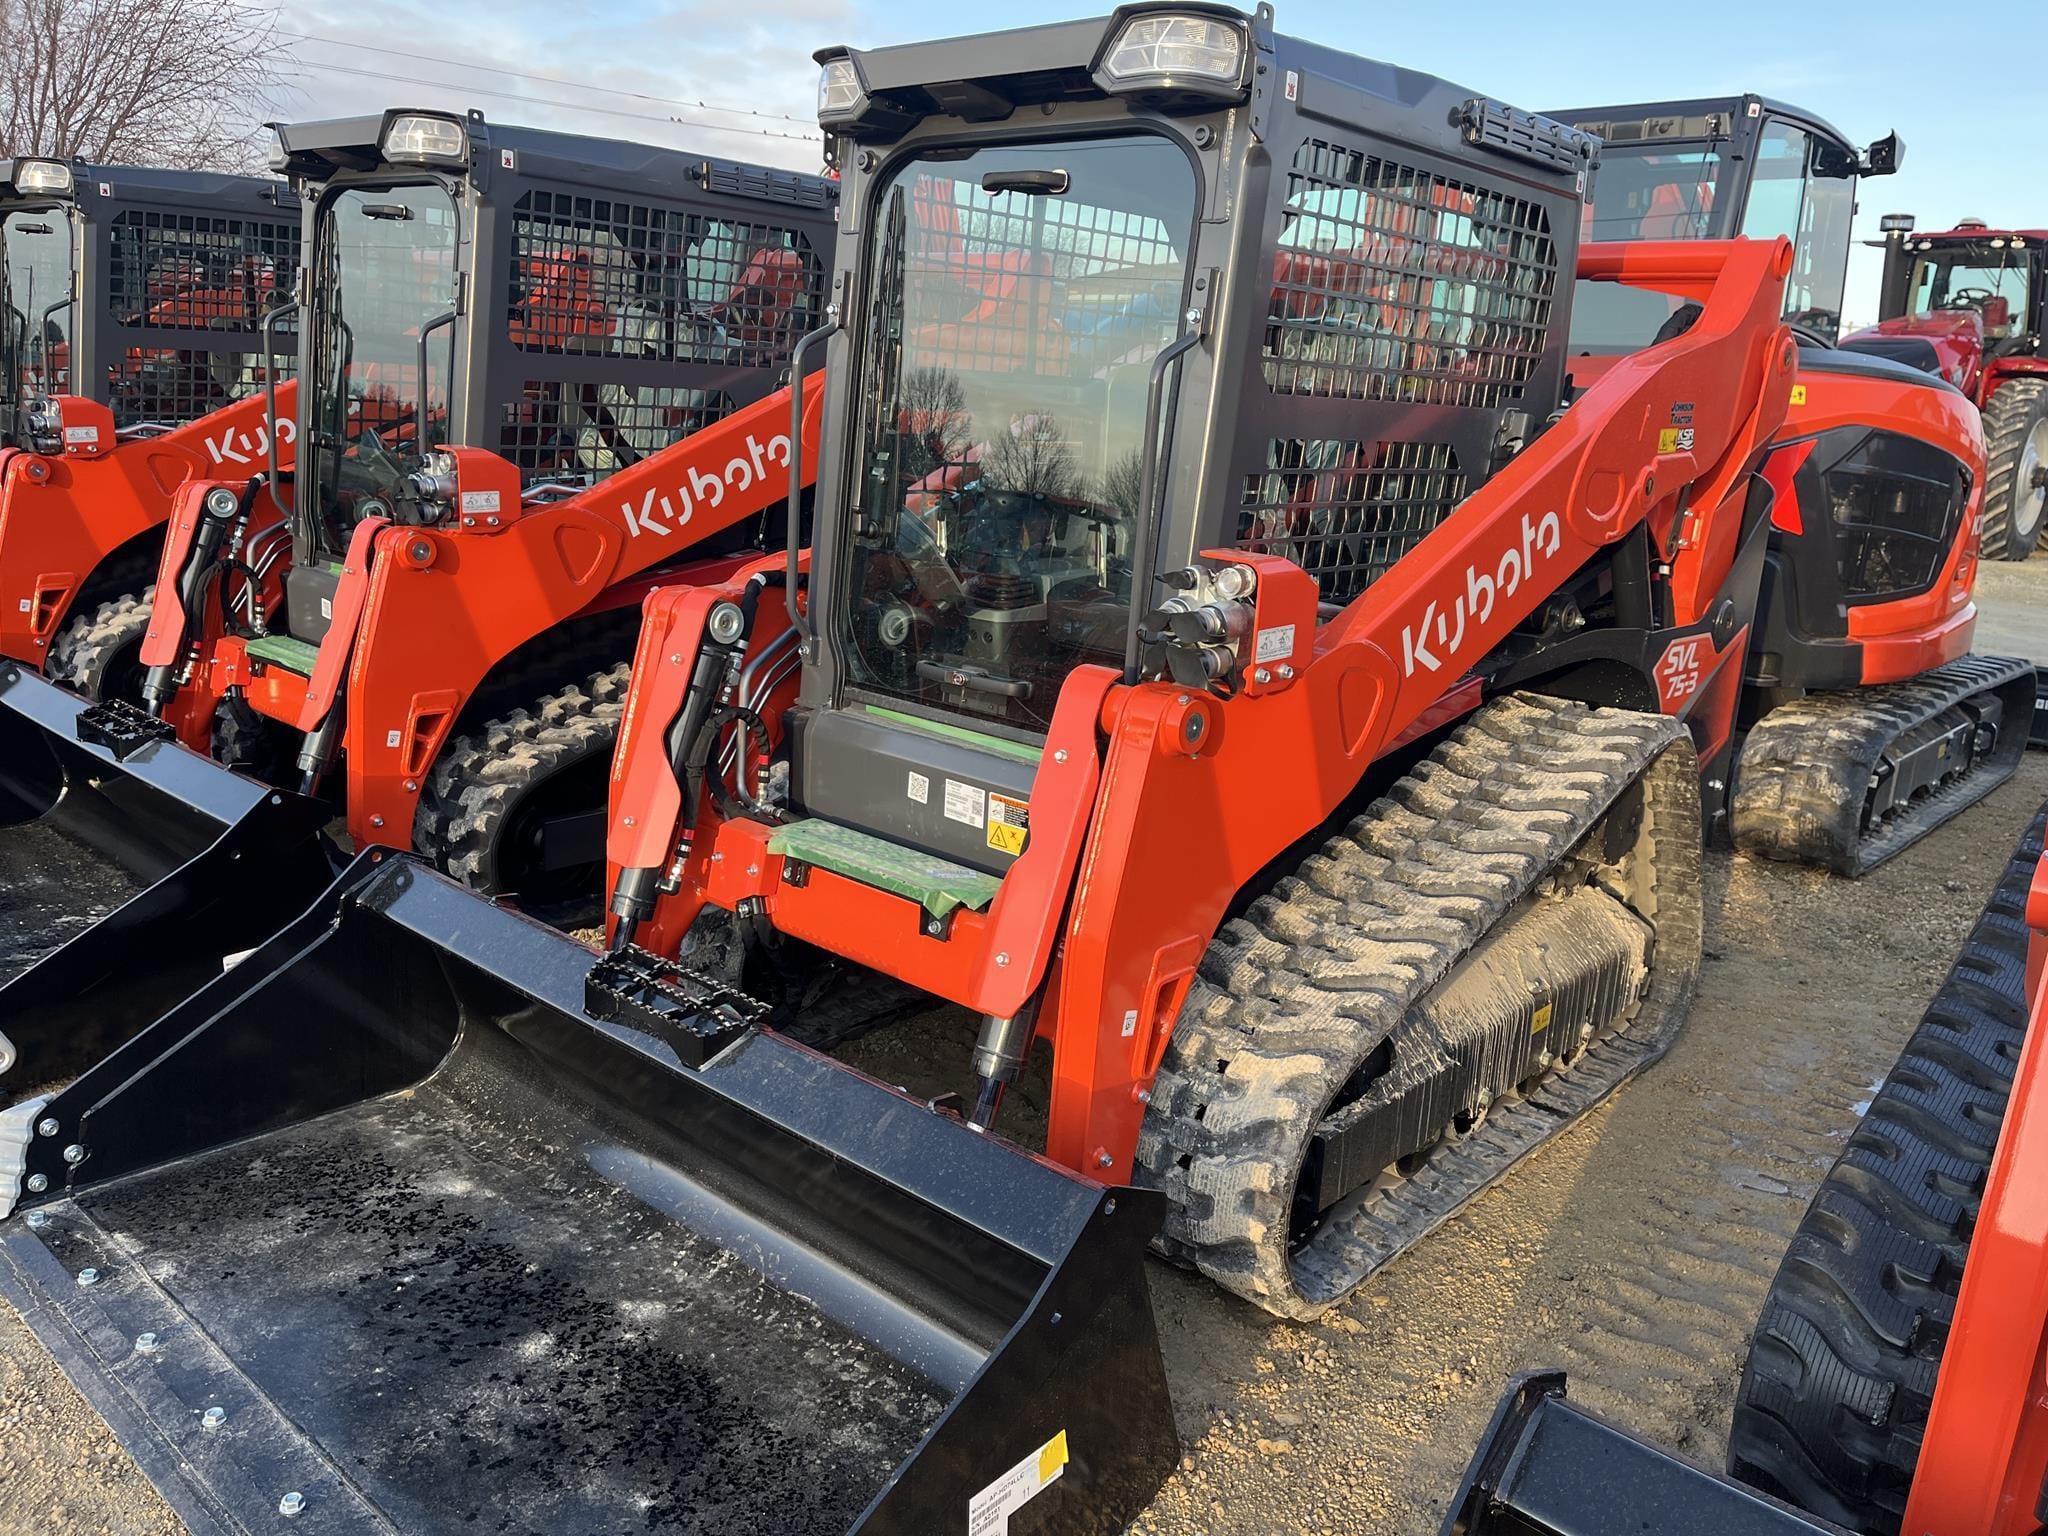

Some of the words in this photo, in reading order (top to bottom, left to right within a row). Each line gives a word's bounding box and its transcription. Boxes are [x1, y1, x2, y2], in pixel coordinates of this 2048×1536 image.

[621, 434, 791, 538] Kubota
[1402, 511, 1560, 678] Kubota
[1663, 642, 1699, 675] SVL
